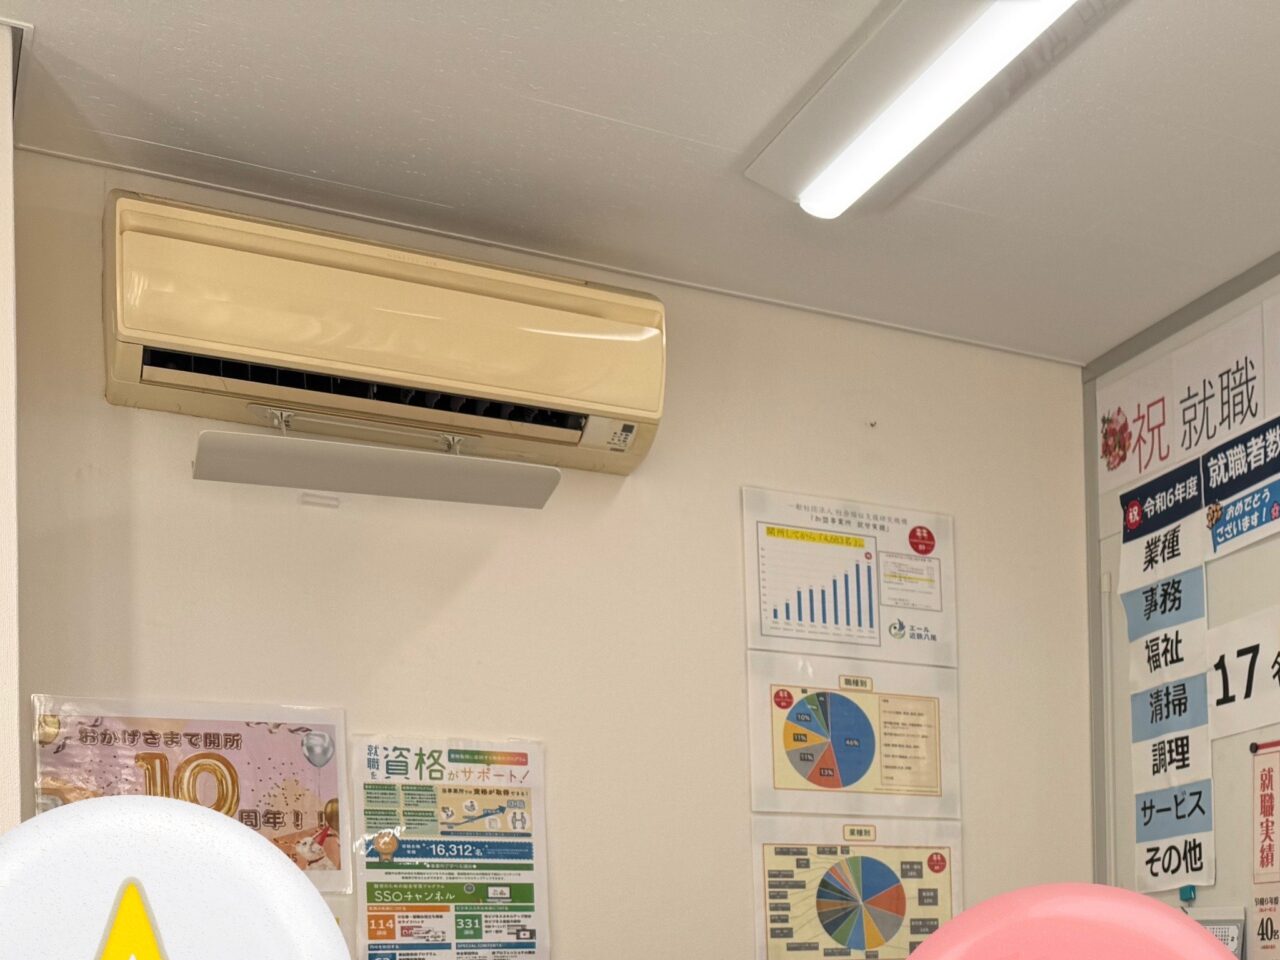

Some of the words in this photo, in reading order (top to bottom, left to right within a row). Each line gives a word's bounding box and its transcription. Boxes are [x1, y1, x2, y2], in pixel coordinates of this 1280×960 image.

[1132, 397, 1170, 474] 祝
[1178, 356, 1258, 451] 就職
[1143, 478, 1199, 518] 令和6年度
[1225, 489, 1271, 519] おめでとう
[1142, 525, 1181, 572] 業種
[1142, 579, 1182, 621] 事務
[1145, 630, 1184, 673] 福祉
[1214, 643, 1260, 706] 17
[1150, 683, 1188, 724] 清掃
[78, 727, 243, 751] おかげさまで開所
[1152, 736, 1190, 776] 調理
[382, 746, 446, 780] 資格
[448, 767, 530, 784] がサポート！
[134, 752, 241, 815] 10
[1141, 790, 1206, 826] サービス
[1259, 768, 1275, 868] 就職実績
[430, 844, 472, 857] 16,312
[1145, 839, 1203, 877] その他
[374, 890, 455, 902] SSOチャンネル
[369, 919, 394, 929] 114
[456, 918, 481, 929] 331
